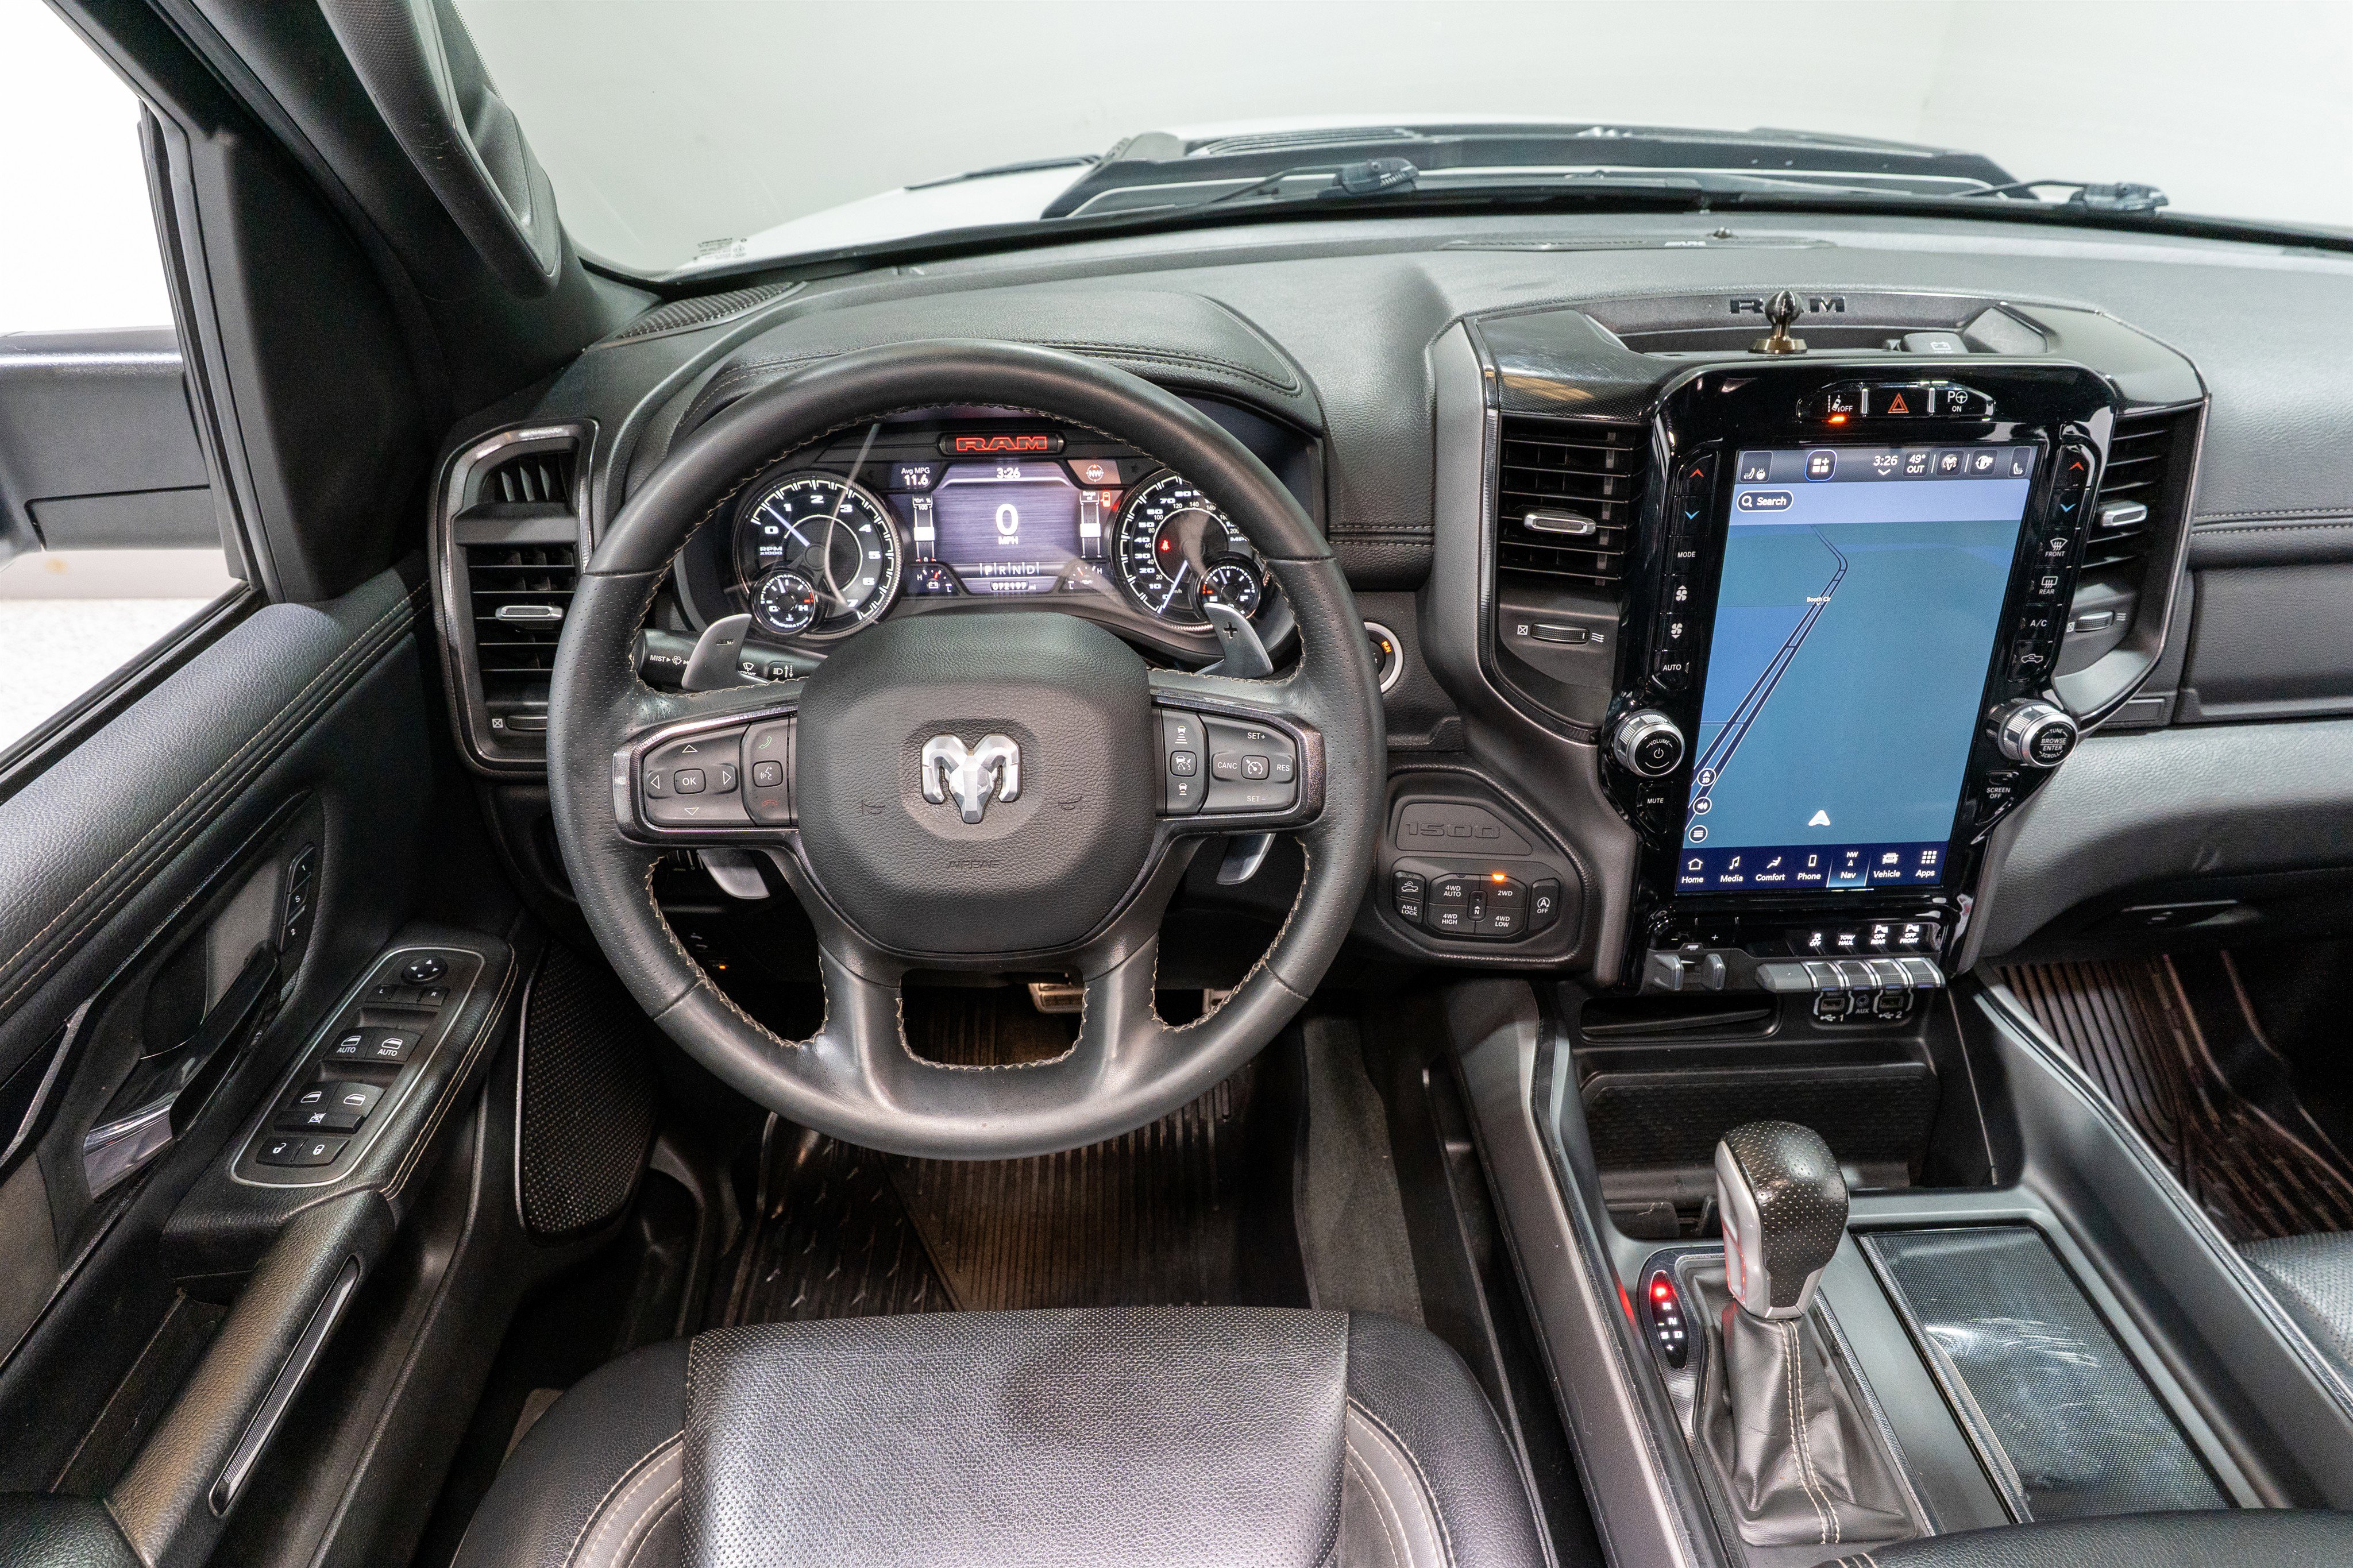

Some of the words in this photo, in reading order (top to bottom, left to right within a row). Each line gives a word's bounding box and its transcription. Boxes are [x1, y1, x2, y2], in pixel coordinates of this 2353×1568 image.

[1730, 296, 1845, 314] RM
[956, 436, 1047, 451] RAM
[1873, 454, 1898, 467] 3:26
[997, 467, 1021, 479] 3:26
[1907, 464, 1924, 473] OUT
[904, 475, 929, 485] 11.6
[811, 495, 824, 504] 2
[1757, 496, 1787, 507] Search
[784, 503, 792, 512] 1
[840, 504, 853, 512] 3
[996, 503, 1019, 535] 0
[765, 526, 779, 534] 0
[859, 524, 871, 532] 4
[998, 536, 1019, 545] MPH
[869, 551, 881, 559] 5
[985, 565, 993, 575] P
[999, 566, 1006, 574] R
[1012, 565, 1021, 574] N
[1027, 565, 1035, 574] D
[863, 577, 875, 585] 6
[847, 599, 859, 607] 7
[2030, 619, 2047, 627] A/C
[1382, 640, 1391, 653] RUN
[1218, 762, 1237, 770] CANC
[1276, 764, 1290, 772] RES
[682, 777, 697, 786] OK
[1406, 821, 1500, 839] 1500
[1720, 874, 1743, 882] Media
[1756, 873, 1785, 881] Comfort
[1797, 872, 1821, 880] Phone
[1873, 870, 1900, 878] Vehicle
[1915, 870, 1935, 879] Apps
[1681, 876, 1703, 884] Home
